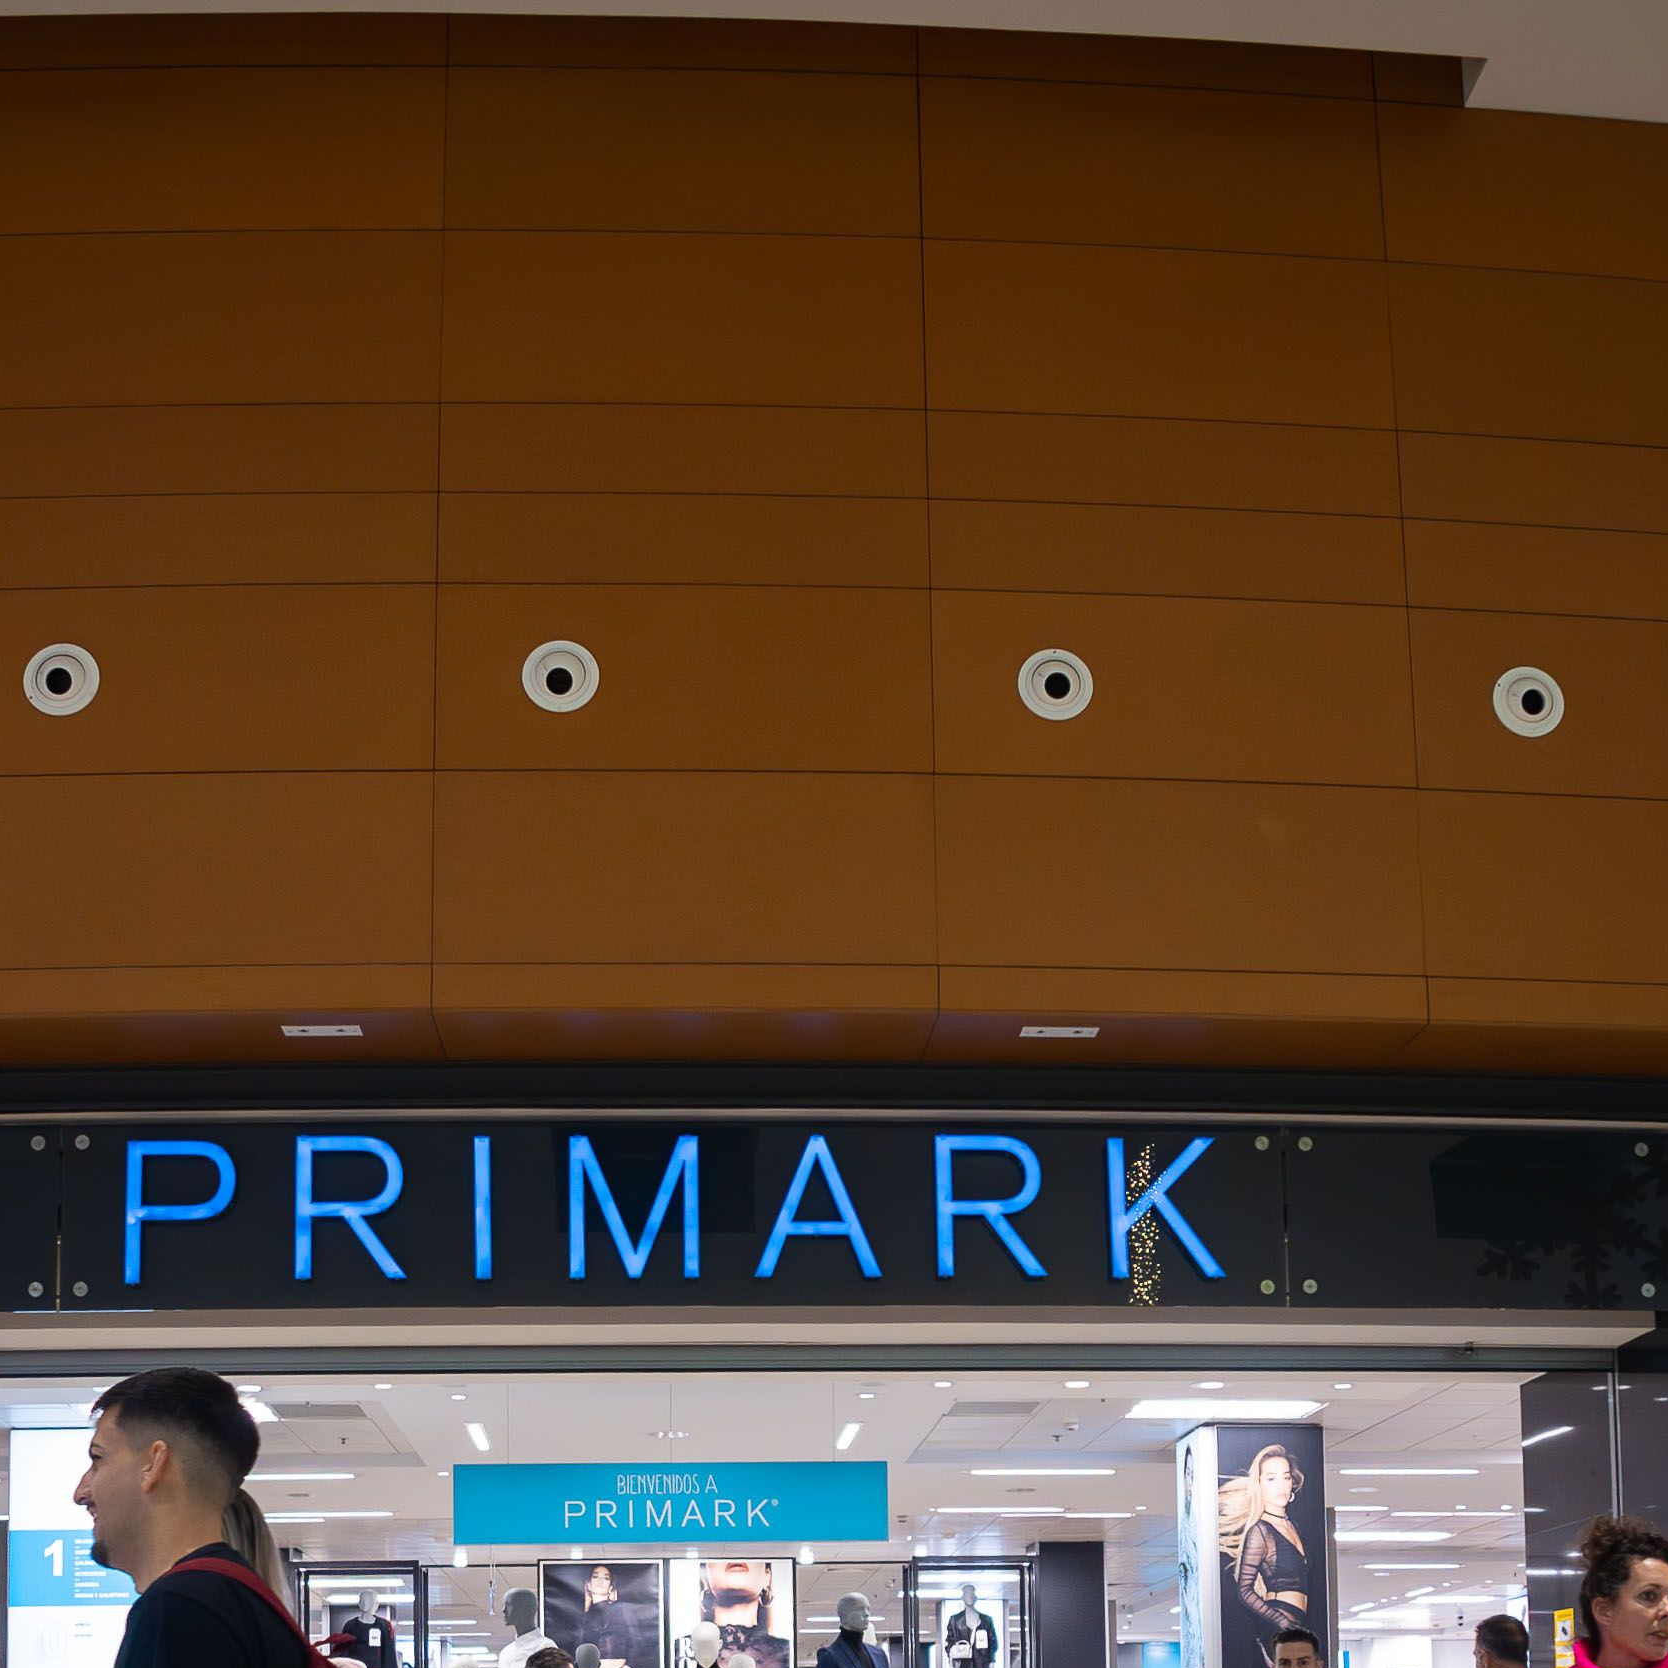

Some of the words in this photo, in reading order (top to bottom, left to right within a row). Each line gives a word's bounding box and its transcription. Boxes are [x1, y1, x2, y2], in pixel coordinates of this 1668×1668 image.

[124, 1135, 1226, 1285] PRIMARK
[617, 1474, 700, 1495] BIENVENIDOS
[705, 1475, 719, 1494] A
[44, 1539, 64, 1577] 1
